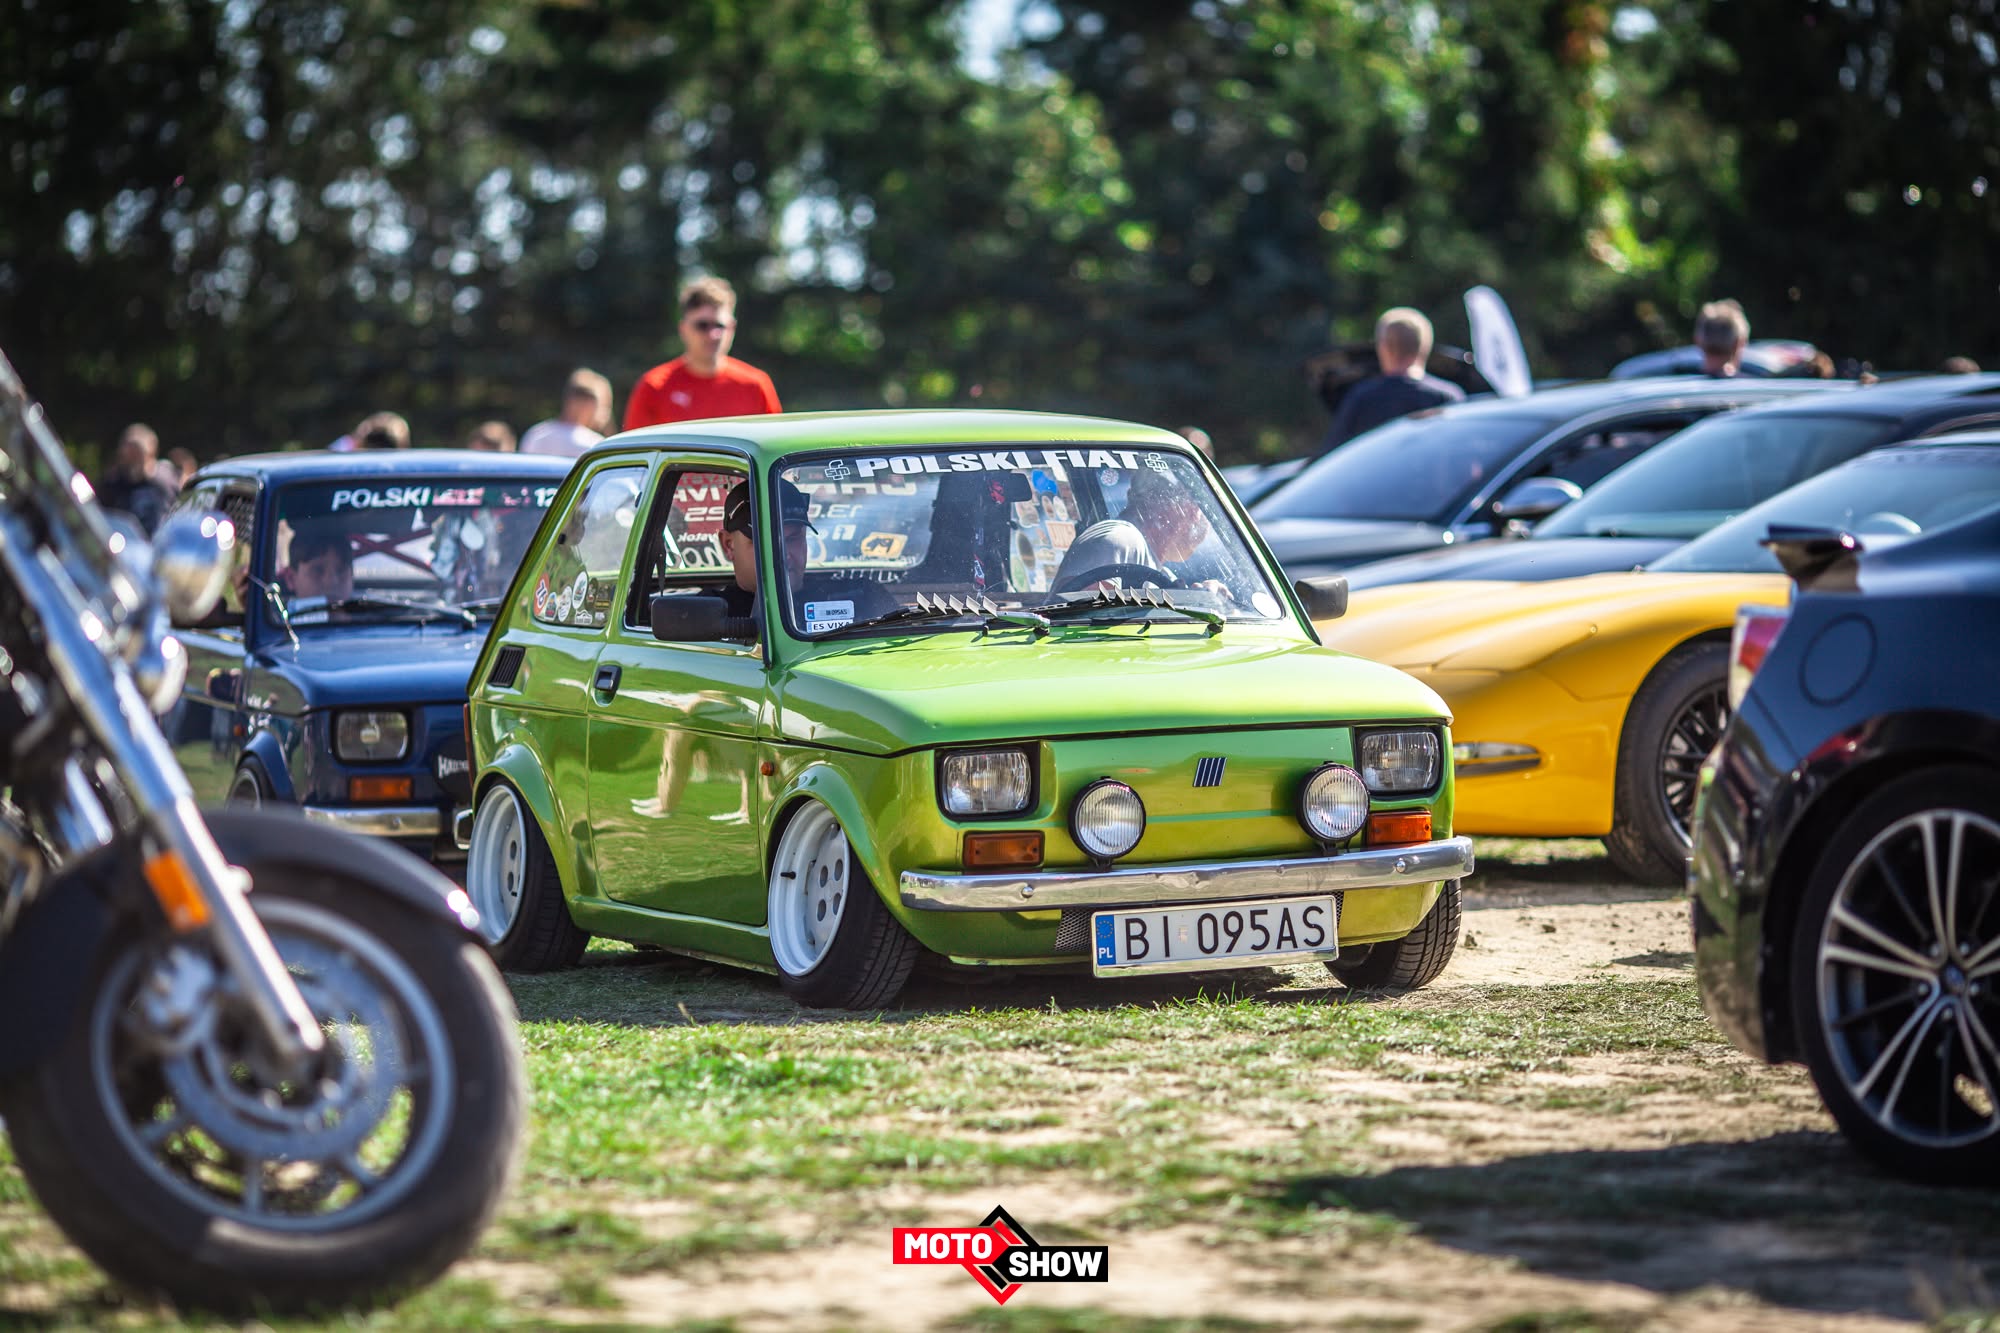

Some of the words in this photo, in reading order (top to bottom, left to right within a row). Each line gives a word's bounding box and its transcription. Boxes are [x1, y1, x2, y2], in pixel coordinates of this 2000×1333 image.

[856, 451, 1033, 478] POLSKI
[1041, 450, 1139, 470] FIAT
[331, 486, 431, 511] POLSKI
[534, 487, 559, 507] 12
[813, 623, 825, 631] ES
[1125, 915, 1170, 961] BI
[1197, 905, 1326, 955] 095AS
[1098, 947, 1114, 959] PL
